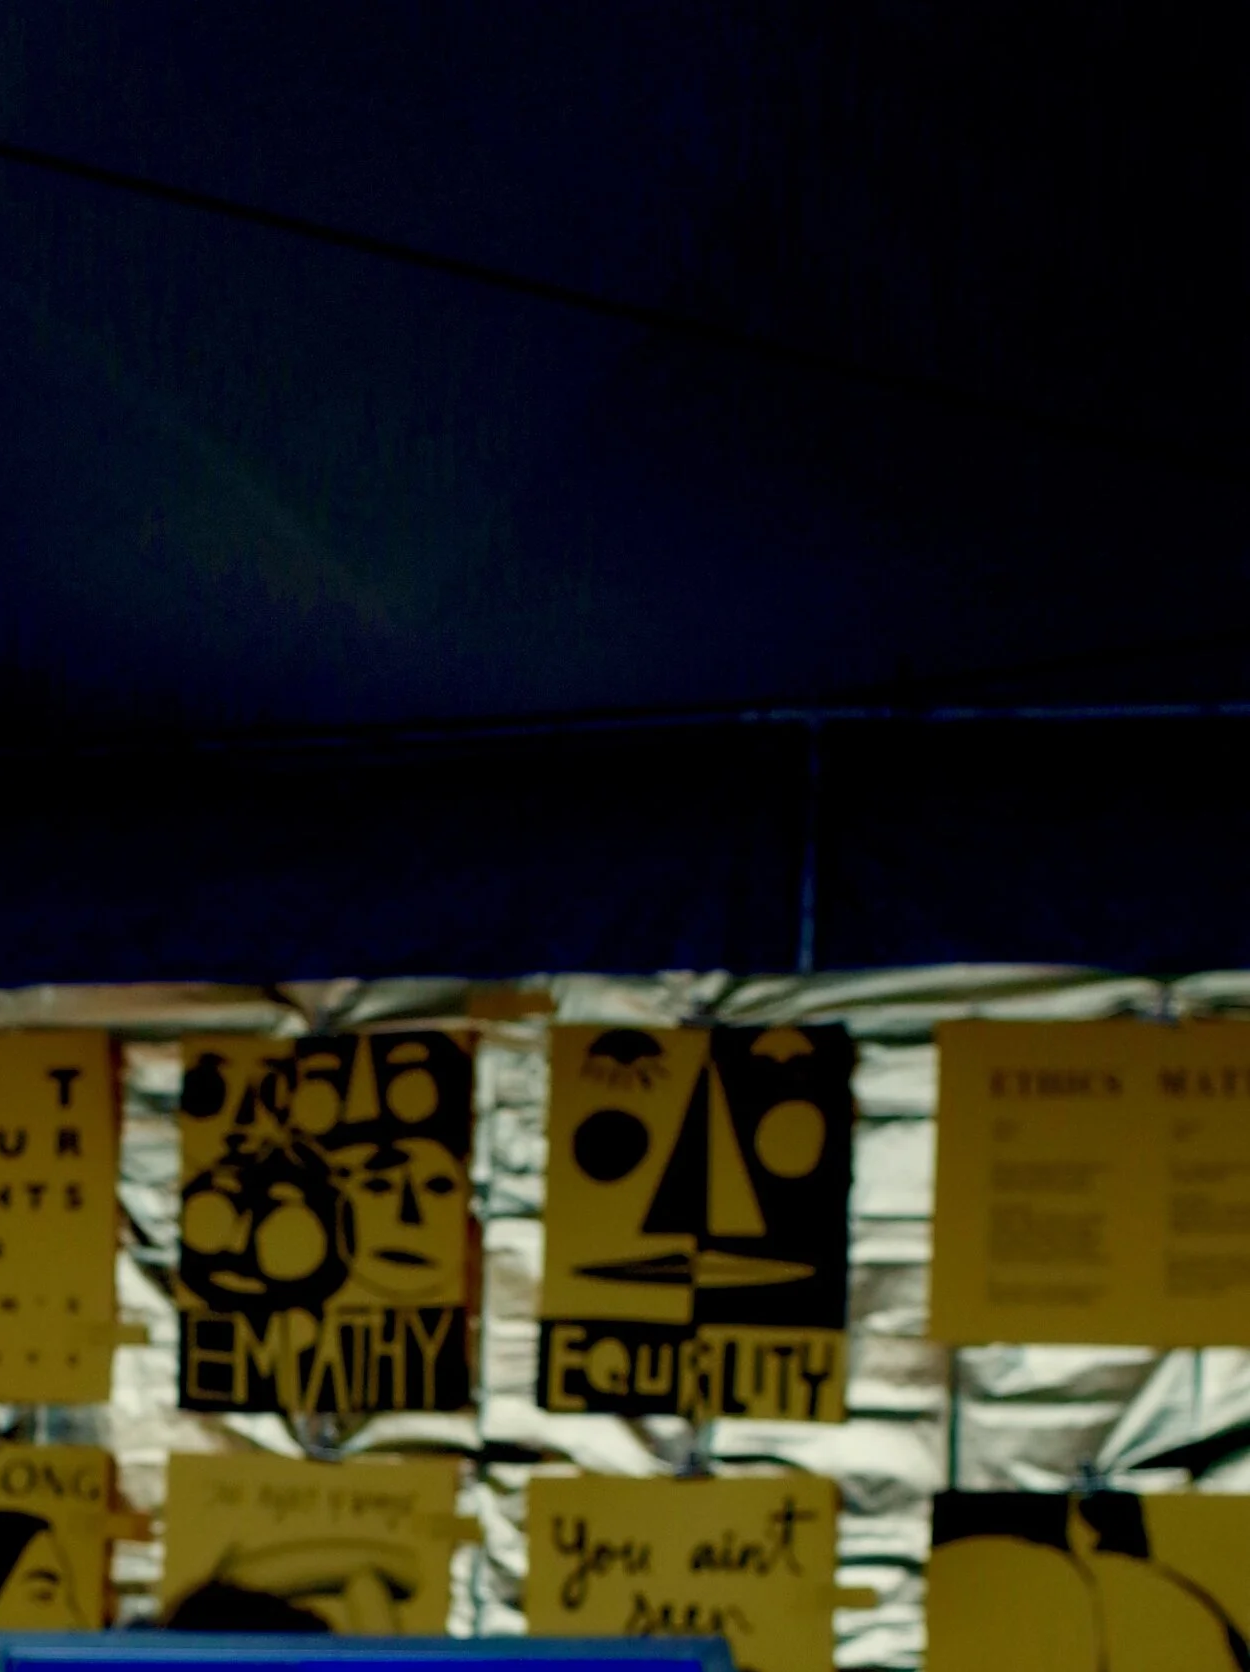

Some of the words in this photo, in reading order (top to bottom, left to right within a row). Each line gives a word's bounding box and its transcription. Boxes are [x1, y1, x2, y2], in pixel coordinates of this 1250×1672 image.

[186, 1306, 455, 1413] EMPATHY
[546, 1323, 836, 1418] EQUALITY
[552, 1515, 652, 1612] You
